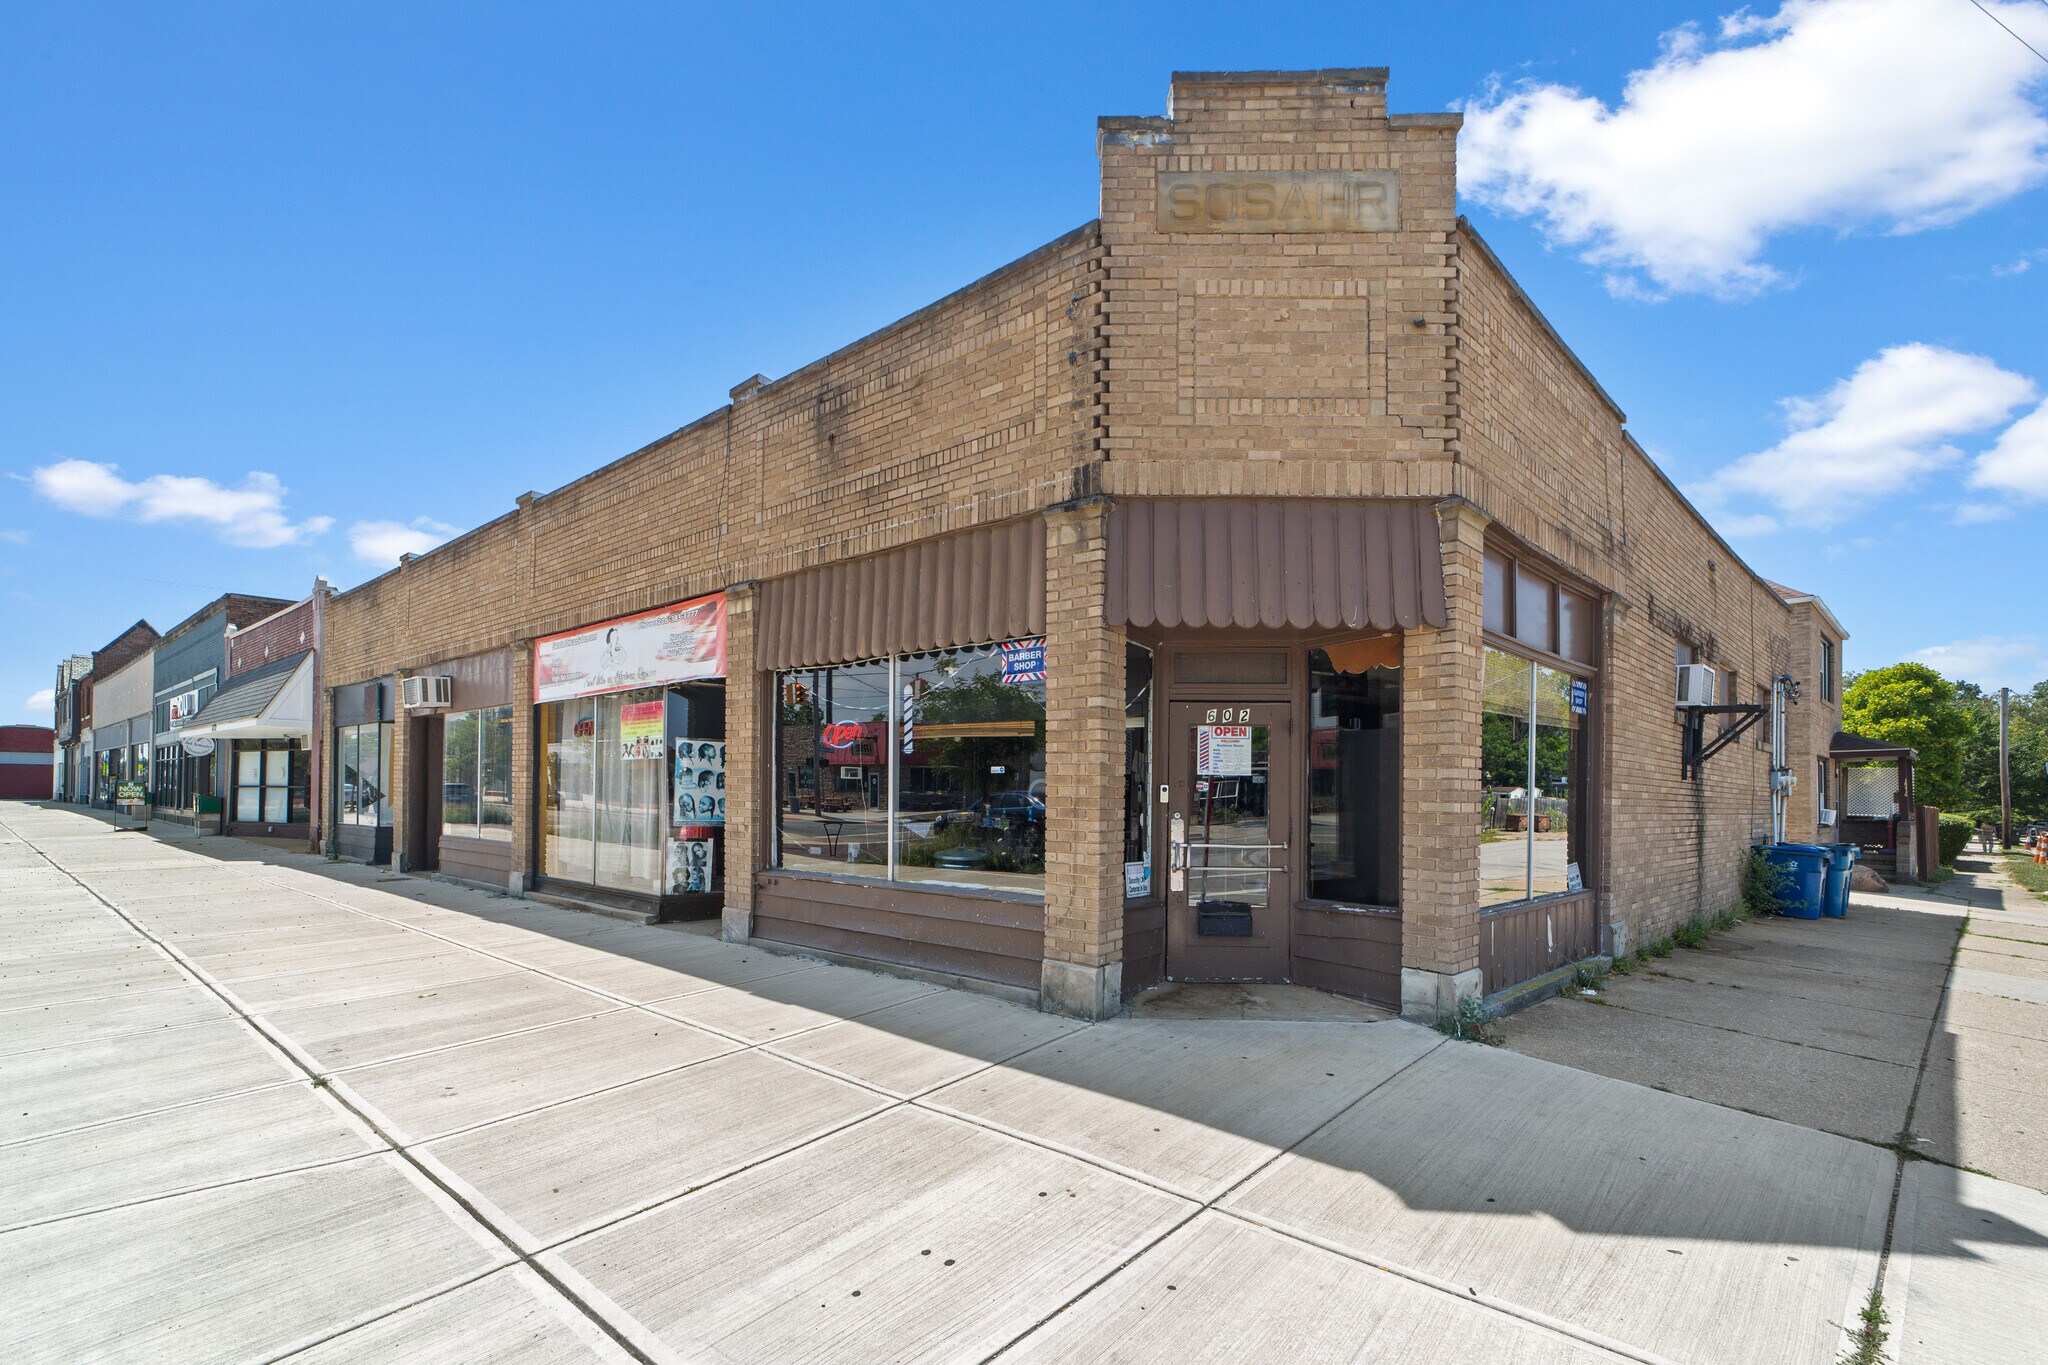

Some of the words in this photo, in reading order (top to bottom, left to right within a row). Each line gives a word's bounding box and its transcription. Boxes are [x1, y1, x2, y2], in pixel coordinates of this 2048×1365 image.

[1169, 182, 1387, 220] SOSAHR
[1008, 650, 1042, 662] BARBER
[1013, 661, 1037, 671] SHOP
[1207, 709, 1248, 721] 602
[823, 723, 863, 746] Open
[1214, 726, 1247, 737] OPEN
